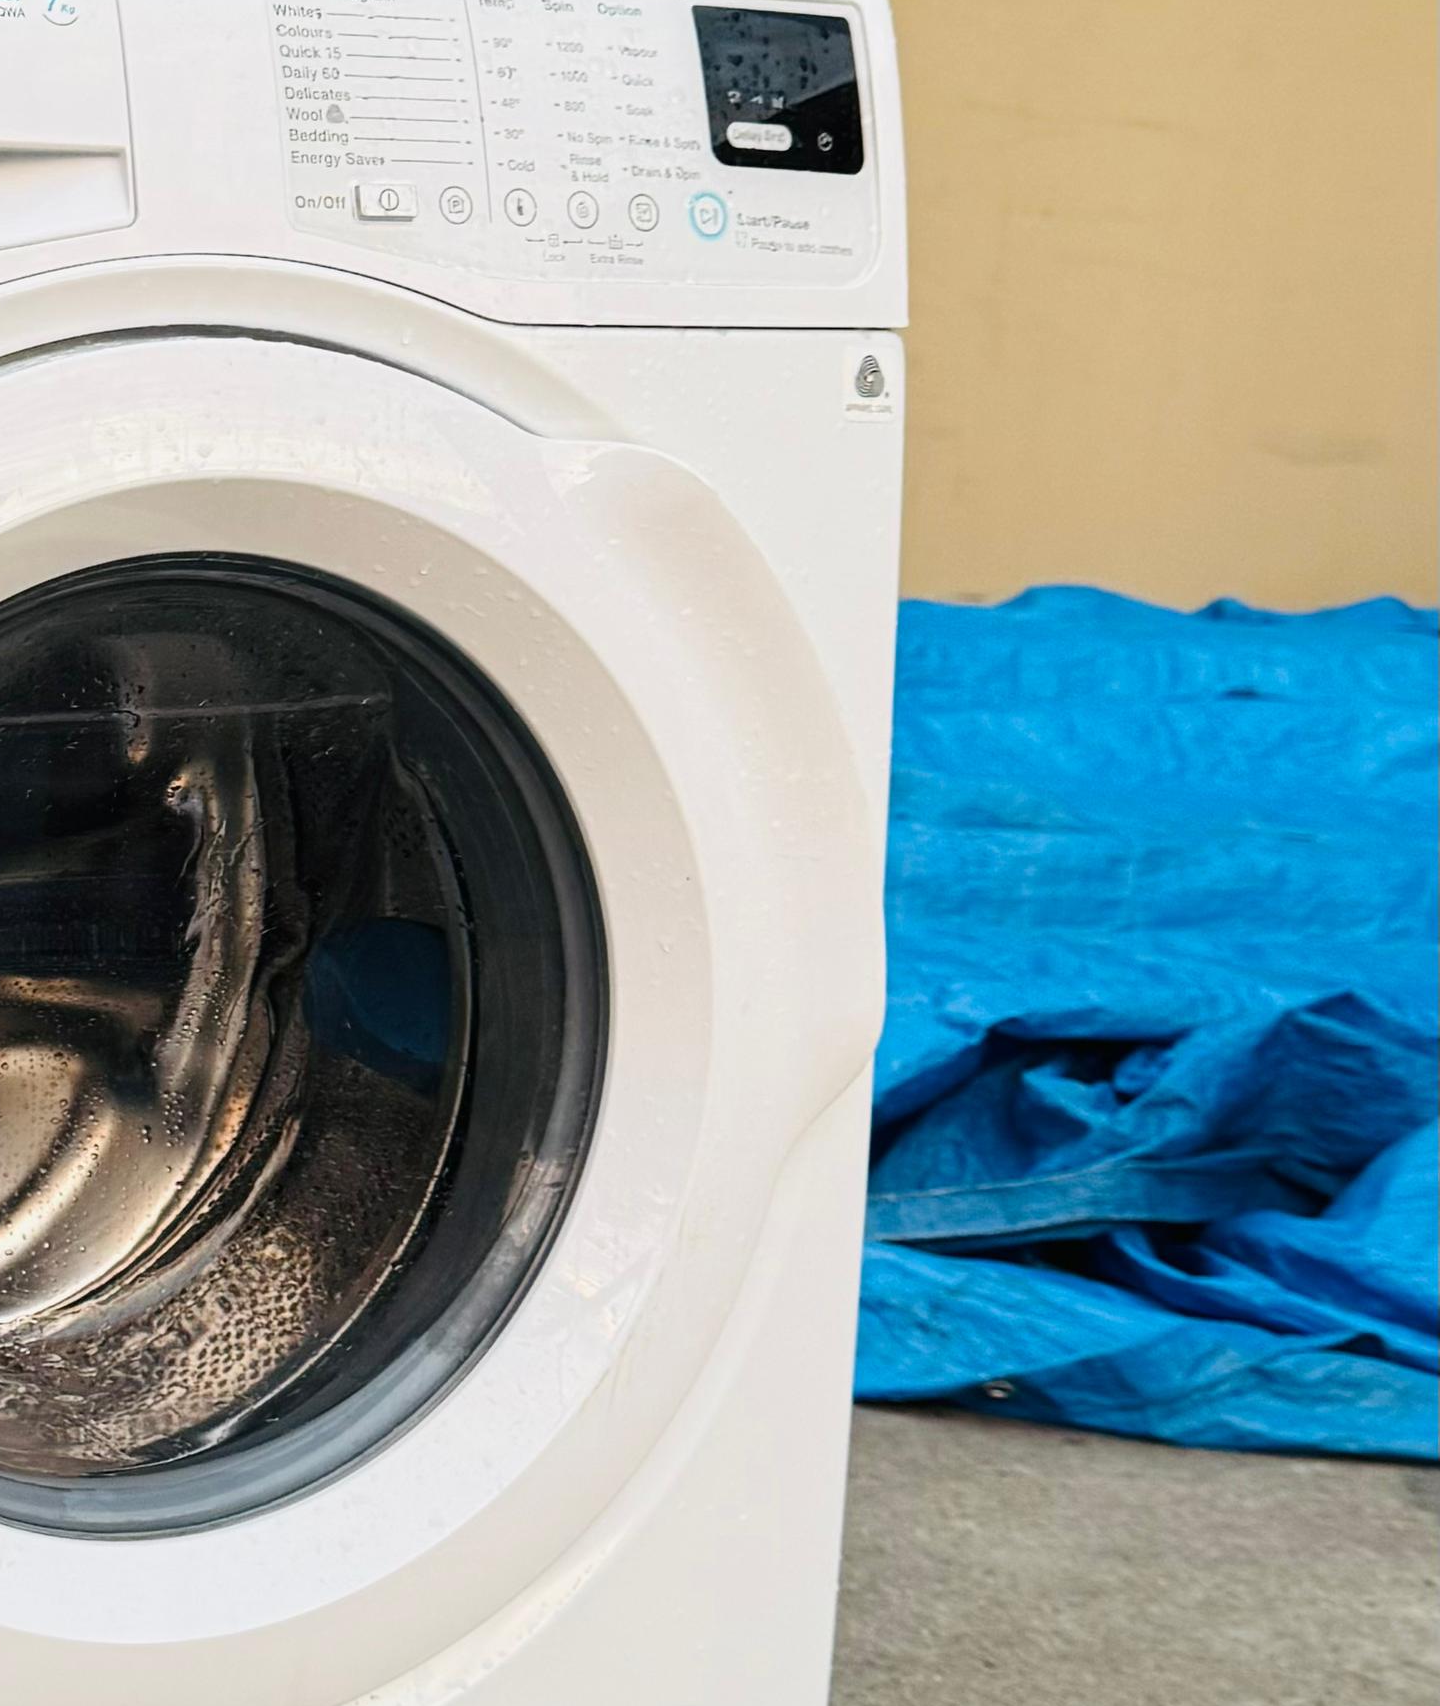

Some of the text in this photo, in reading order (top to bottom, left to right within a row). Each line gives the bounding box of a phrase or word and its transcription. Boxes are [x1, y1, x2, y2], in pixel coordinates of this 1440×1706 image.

[273, 4, 322, 19] Whites
[544, 0, 574, 13] Spin
[597, 2, 642, 17] Option
[276, 24, 333, 39] Colours
[279, 45, 342, 60] Quick 15
[282, 65, 340, 82] Daily 60
[284, 86, 351, 101] Delicates
[286, 106, 322, 121] Wool
[289, 128, 349, 146] Bedding
[567, 131, 613, 146] No Spin
[291, 150, 385, 168] Energy Saver
[507, 159, 535, 172] Cold
[295, 196, 346, 210] On/Off
